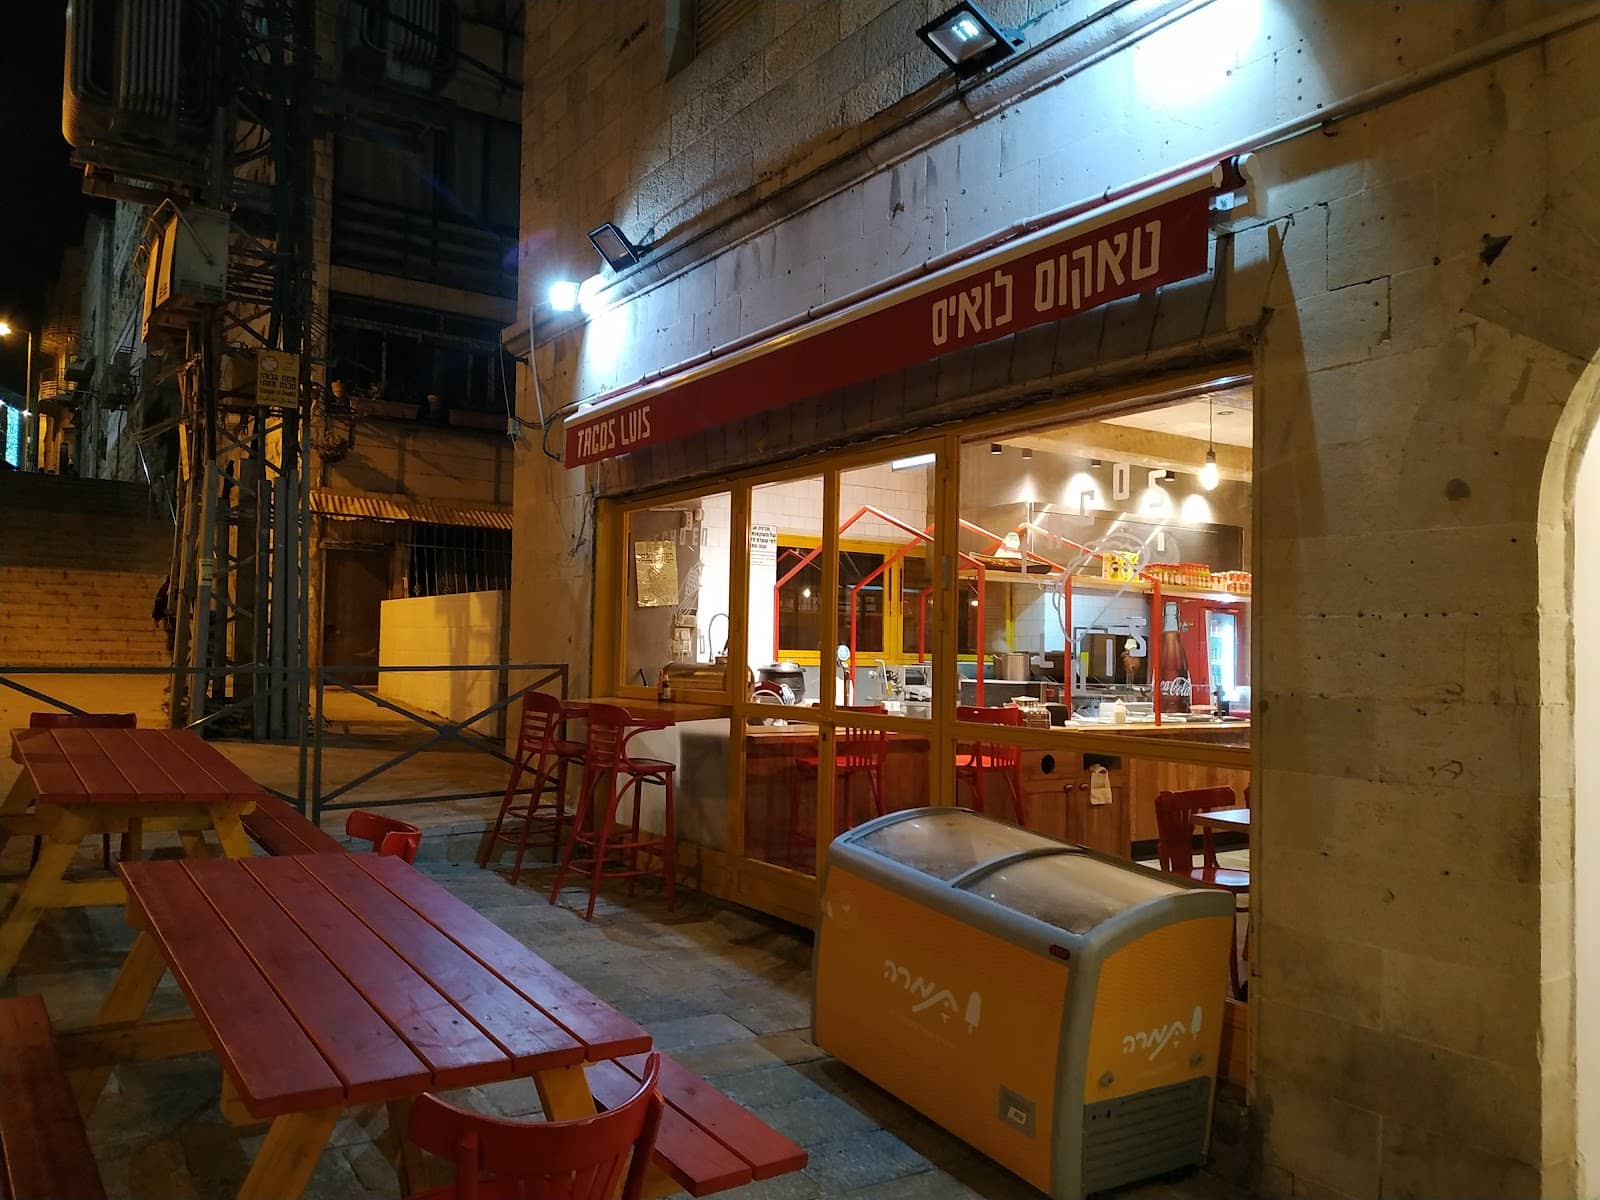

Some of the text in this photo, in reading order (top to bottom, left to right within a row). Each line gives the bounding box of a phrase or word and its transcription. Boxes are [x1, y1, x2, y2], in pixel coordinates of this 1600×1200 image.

[932, 219, 1162, 347] טאקוס לואיס
[577, 405, 651, 459] TACOS LUIS
